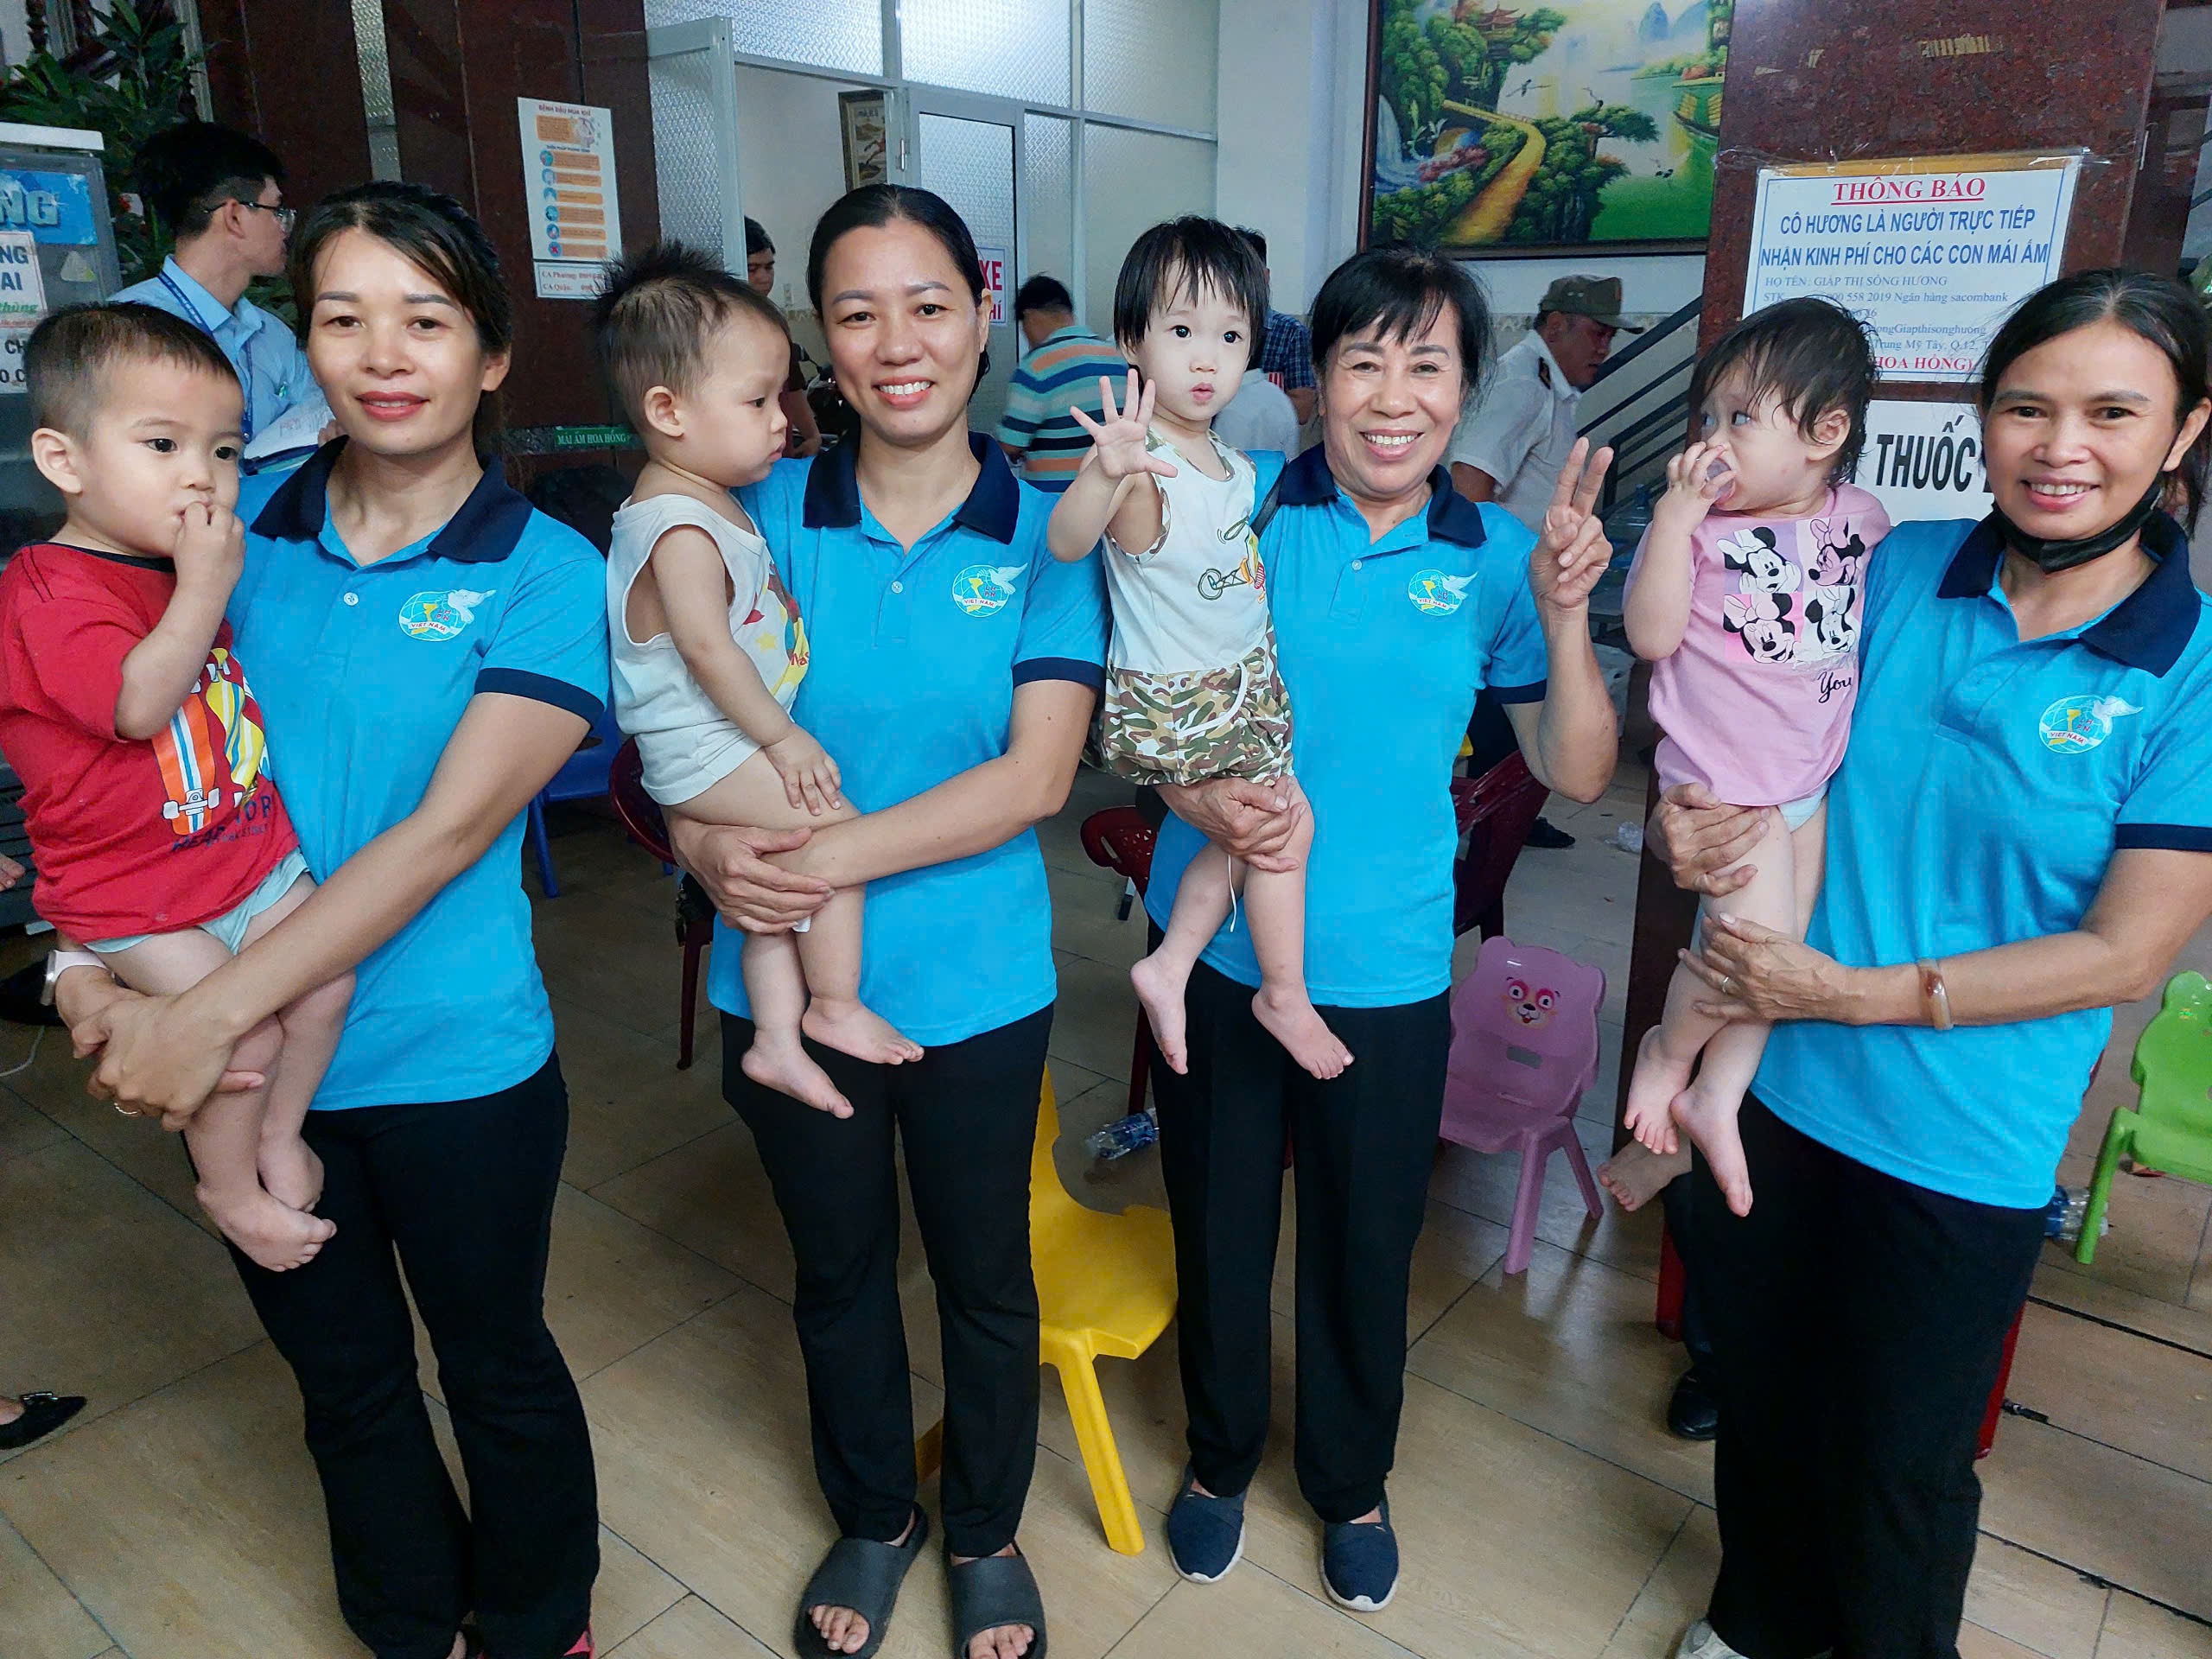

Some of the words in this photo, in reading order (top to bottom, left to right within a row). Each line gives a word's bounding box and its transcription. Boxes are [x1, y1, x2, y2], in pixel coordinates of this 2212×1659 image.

[1833, 176, 1923, 200] THÔNG
[1930, 173, 1986, 198] BÁO
[1781, 212, 1802, 234] CÔ
[1806, 214, 1862, 233] HƯƠNG
[1866, 209, 1885, 232] LÀ
[1891, 207, 1944, 232] NGƯỜI
[1949, 210, 1994, 235] TRỰC
[1999, 205, 2036, 229] TIẾP
[1761, 246, 1802, 270] NHẬN
[1805, 247, 1840, 266] KINH
[1845, 242, 1871, 265] PHÍ
[1873, 245, 1907, 264] CHO
[1910, 240, 1944, 264] CÁC
[1948, 245, 1983, 264] CON
[1987, 238, 2018, 264] MÁI
[2021, 238, 2049, 264] ẤM
[979, 260, 1002, 290] XE
[1814, 275, 1841, 287] GIÁP
[1845, 276, 1864, 288] THỊ
[1902, 276, 1948, 286] HƯƠNG
[1847, 292, 1865, 302] 558
[1866, 292, 1891, 302] 2019
[1894, 292, 1920, 304] Ngân
[1923, 292, 1948, 304] hàng
[1951, 292, 2008, 302] sacombank
[1876, 415, 1976, 492] THUỐC
